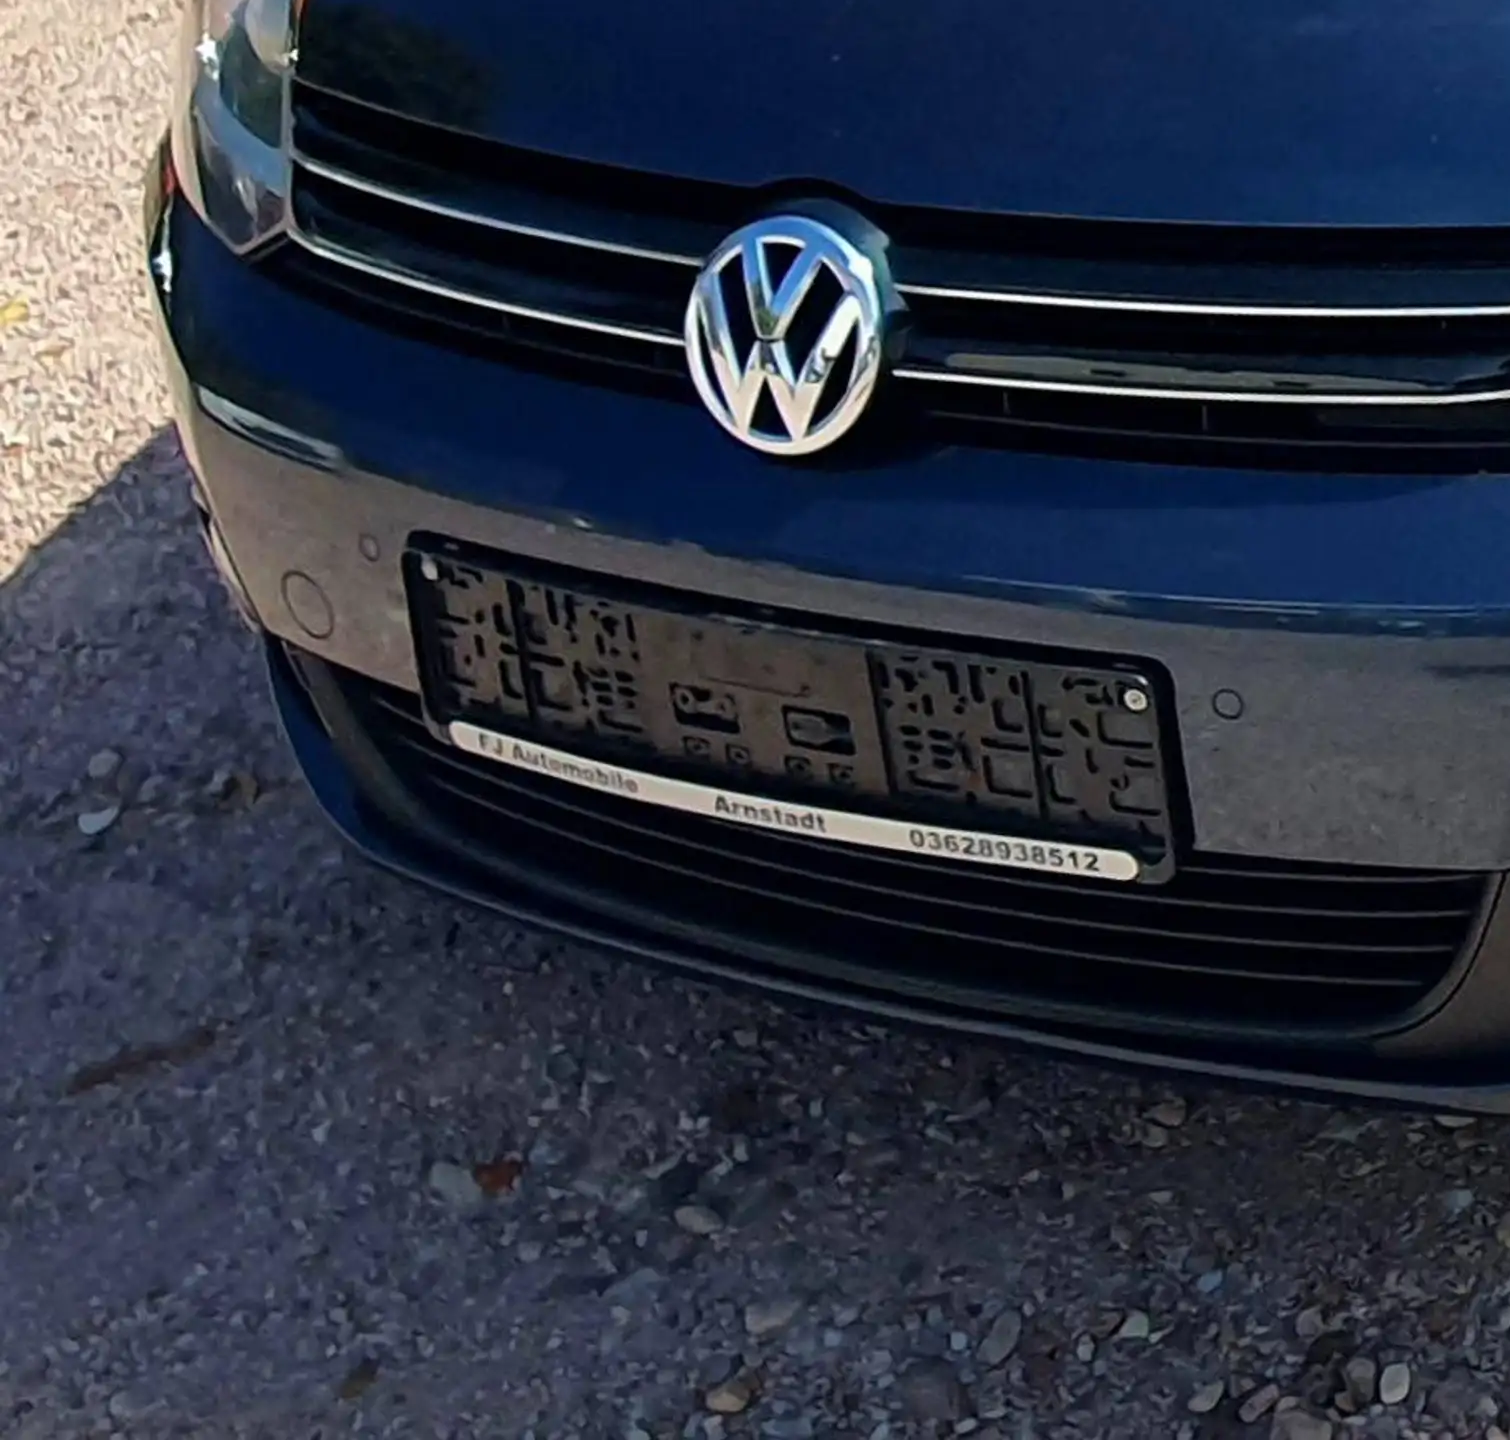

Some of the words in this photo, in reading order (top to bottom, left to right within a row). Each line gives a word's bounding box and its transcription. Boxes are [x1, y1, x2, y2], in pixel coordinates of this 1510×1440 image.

[690, 224, 874, 448] VW
[512, 743, 639, 793] Automobile
[714, 795, 828, 833] Arnstadt
[909, 829, 1100, 871] 03628938512
